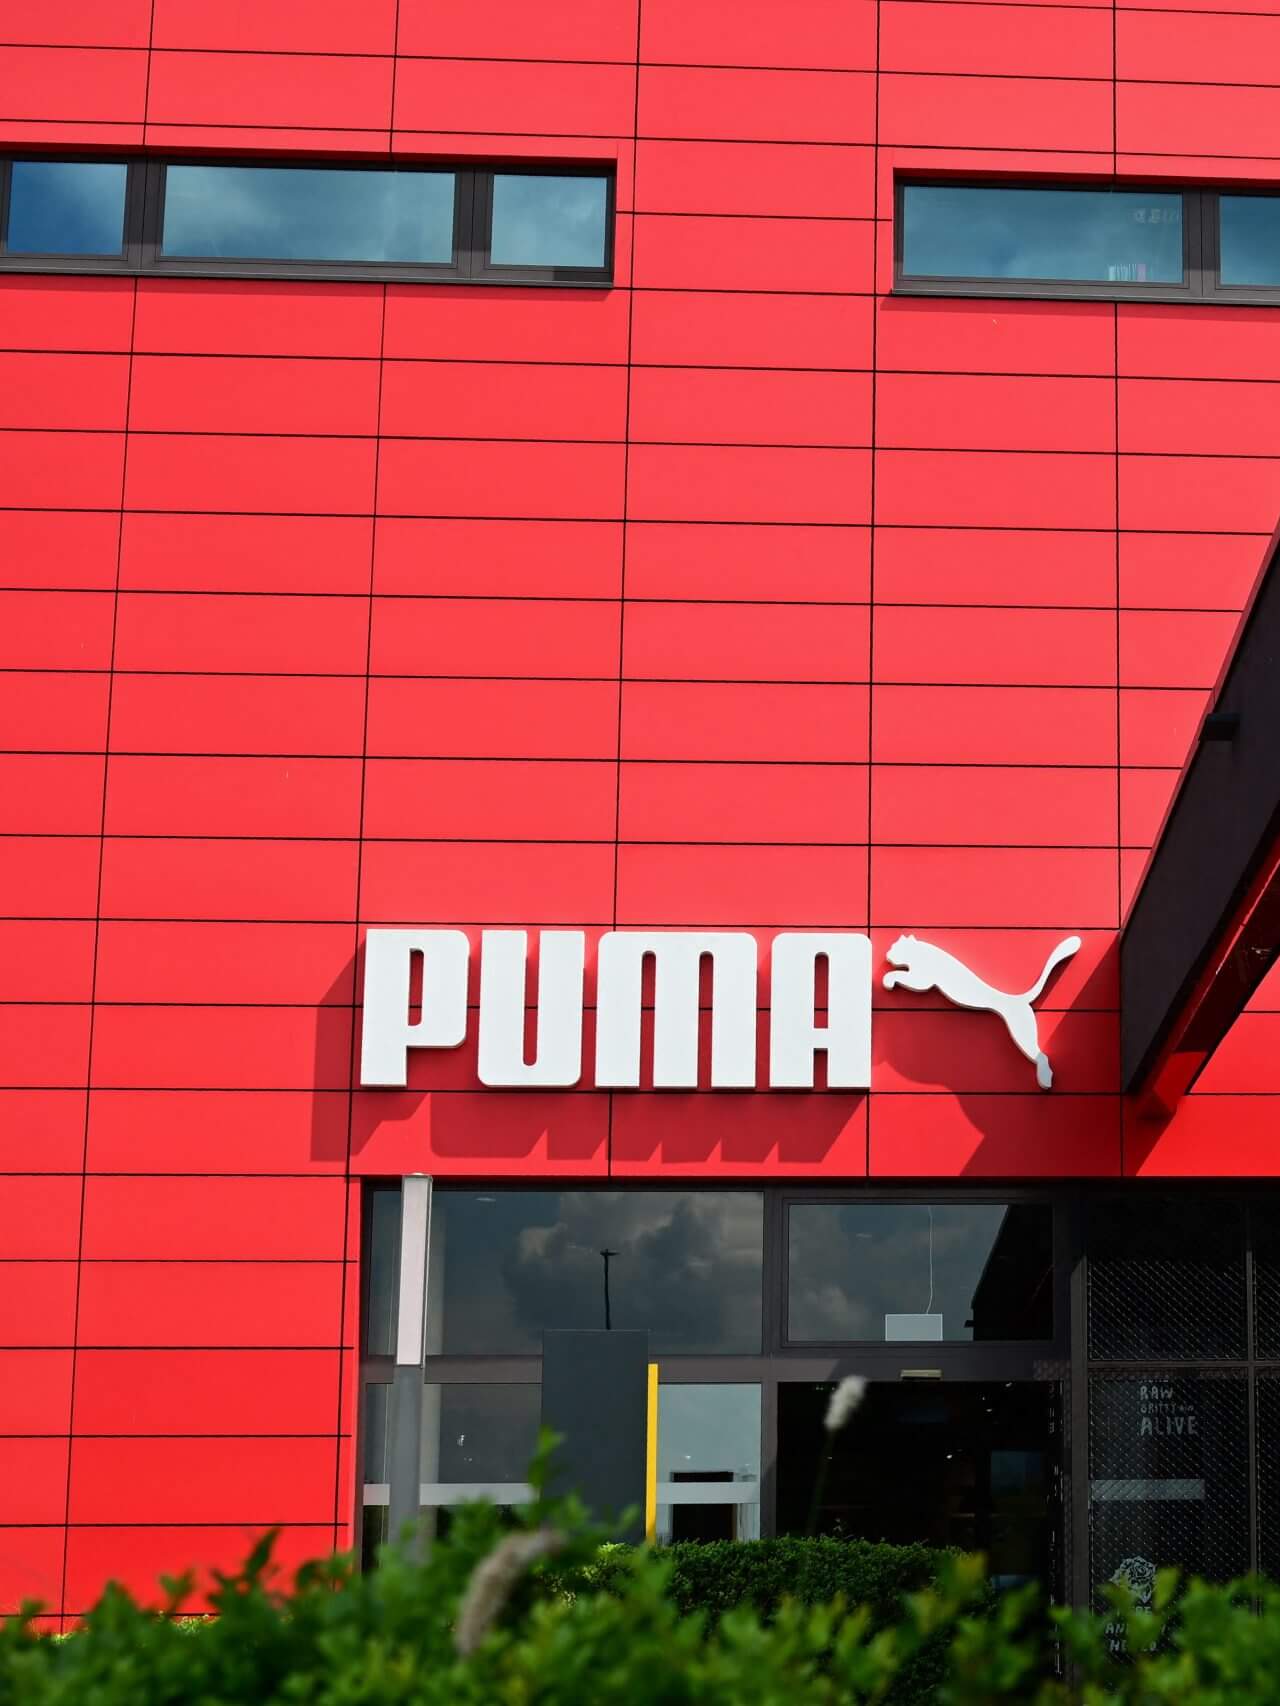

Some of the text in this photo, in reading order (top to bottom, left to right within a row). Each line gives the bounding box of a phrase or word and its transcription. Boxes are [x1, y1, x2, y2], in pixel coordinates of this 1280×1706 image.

[360, 928, 873, 1089] PUMA
[1140, 1385, 1173, 1400] RAW
[1140, 1416, 1197, 1436] ALIVE
